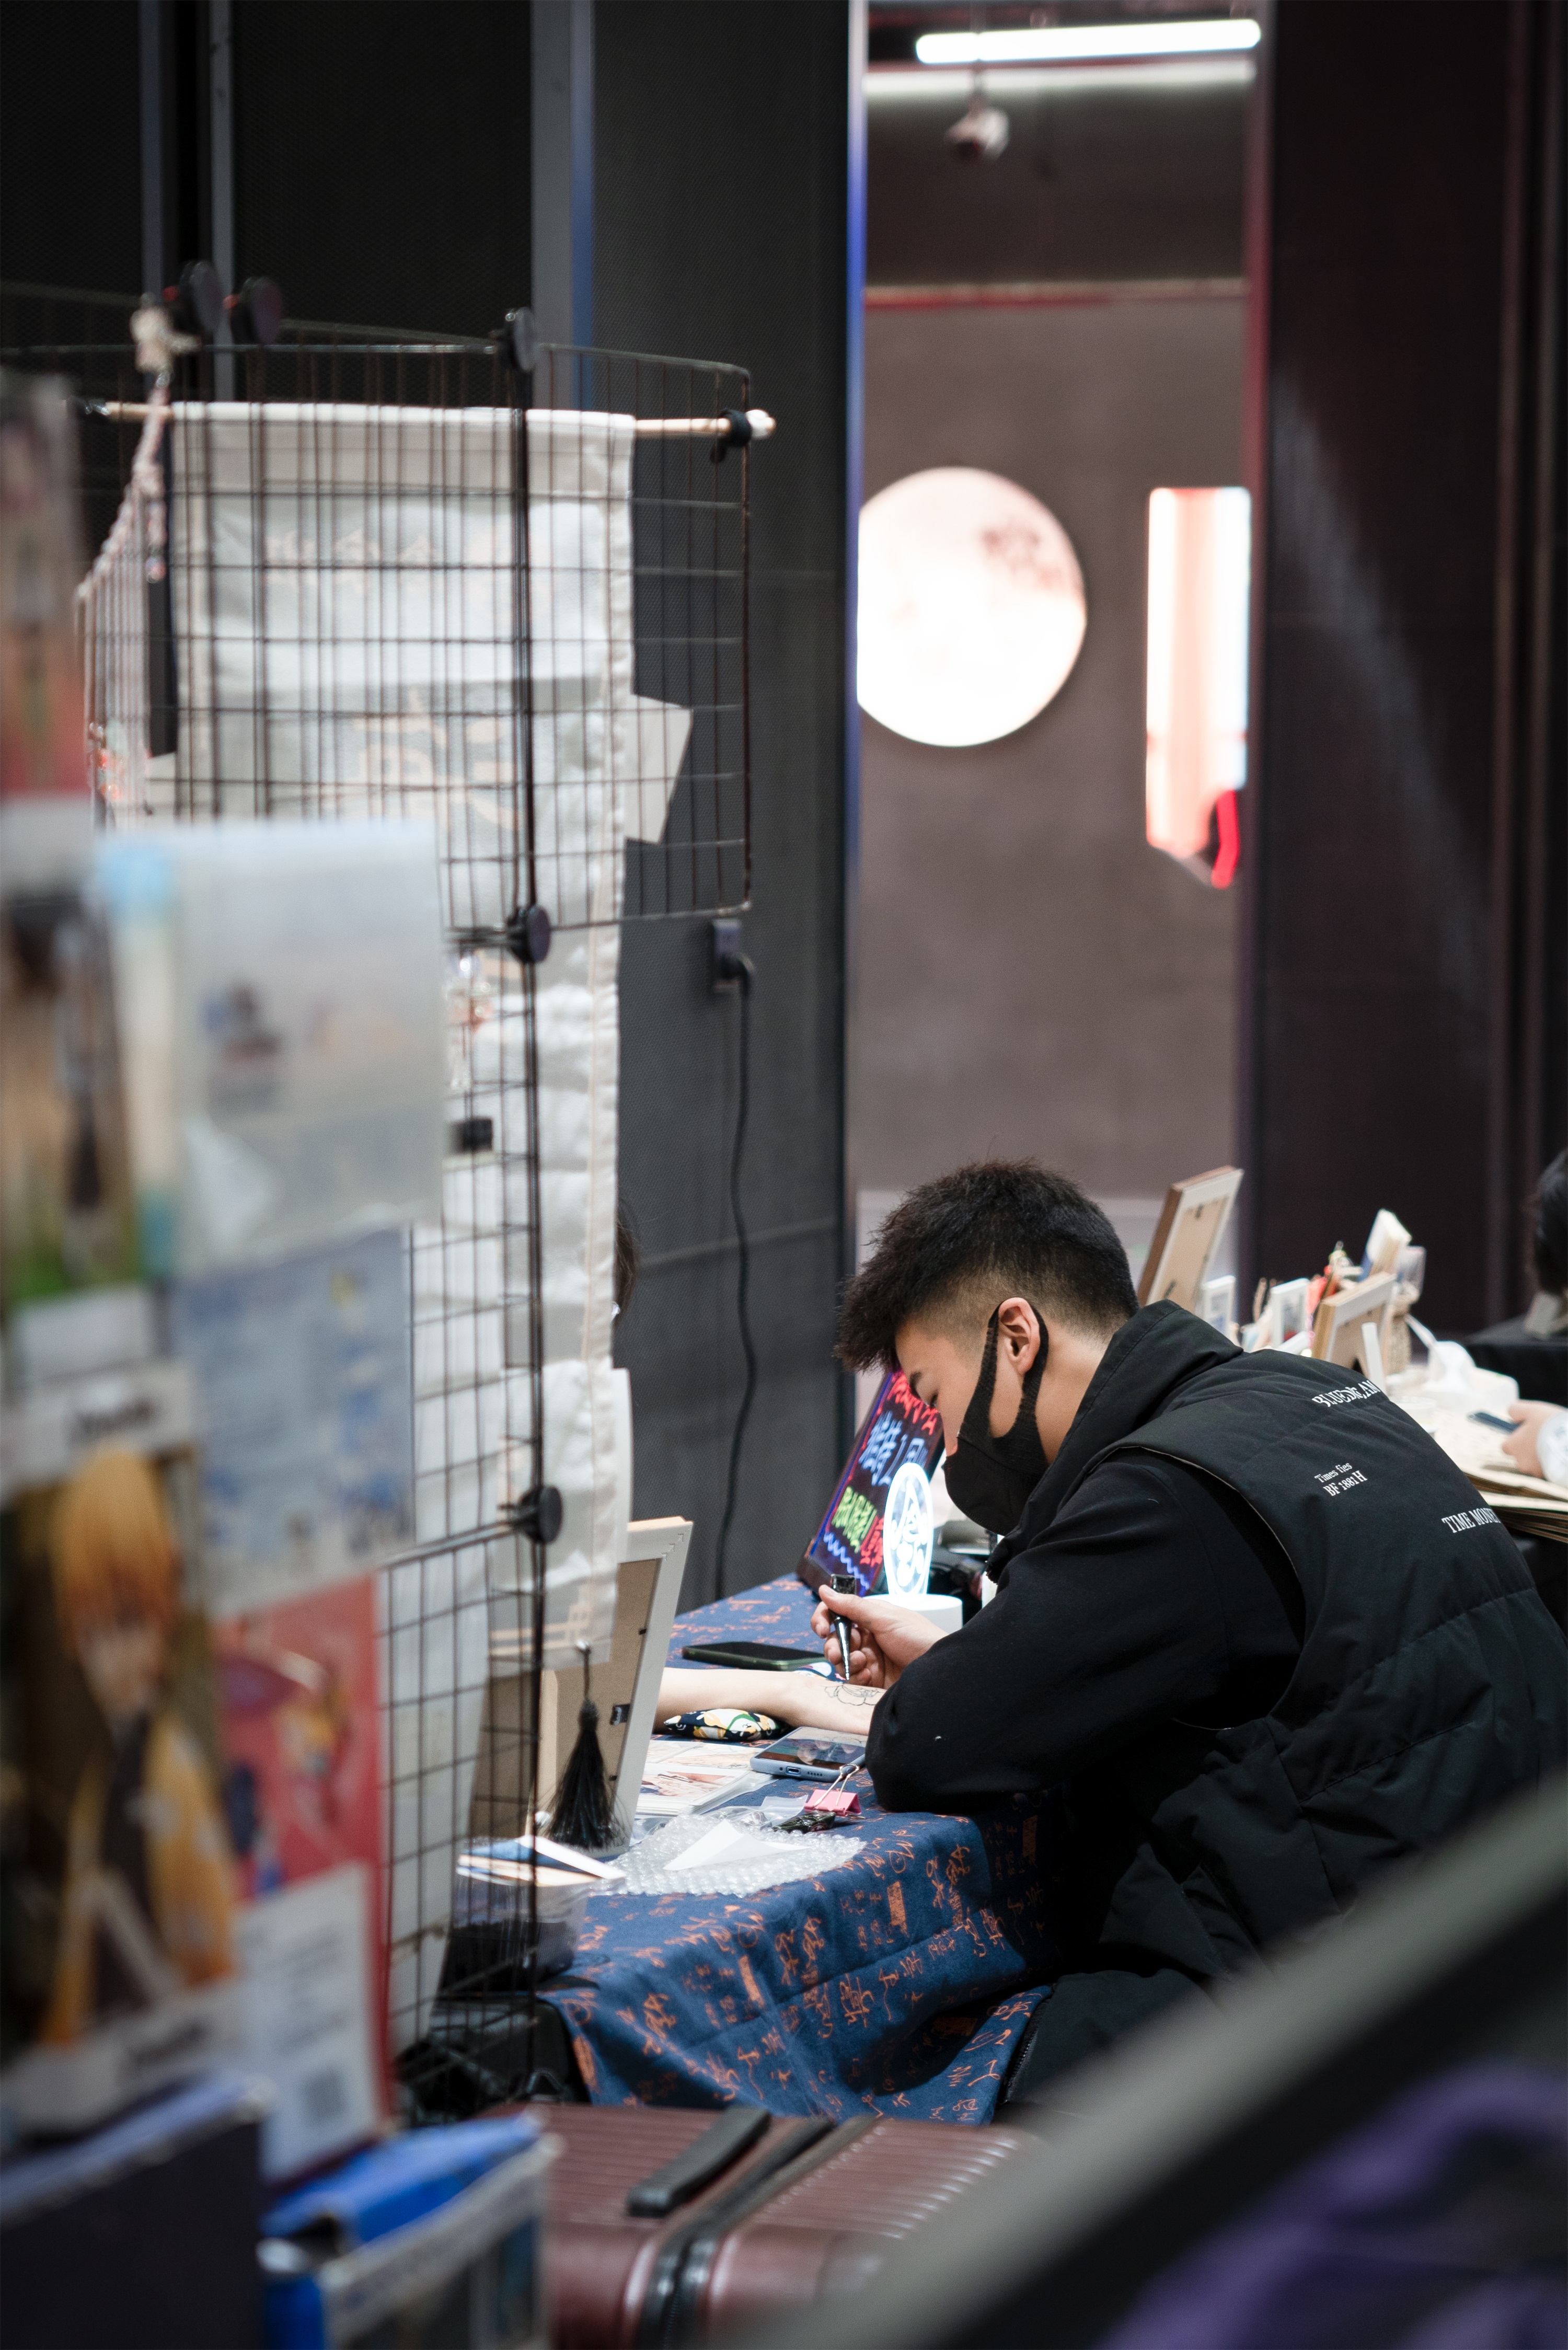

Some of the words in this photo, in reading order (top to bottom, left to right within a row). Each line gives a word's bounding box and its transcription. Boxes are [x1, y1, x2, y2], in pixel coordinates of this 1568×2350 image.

[1313, 1470, 1339, 1483] Times
[1323, 1482, 1341, 1496] BF
[1441, 1512, 1476, 1534] TIME
